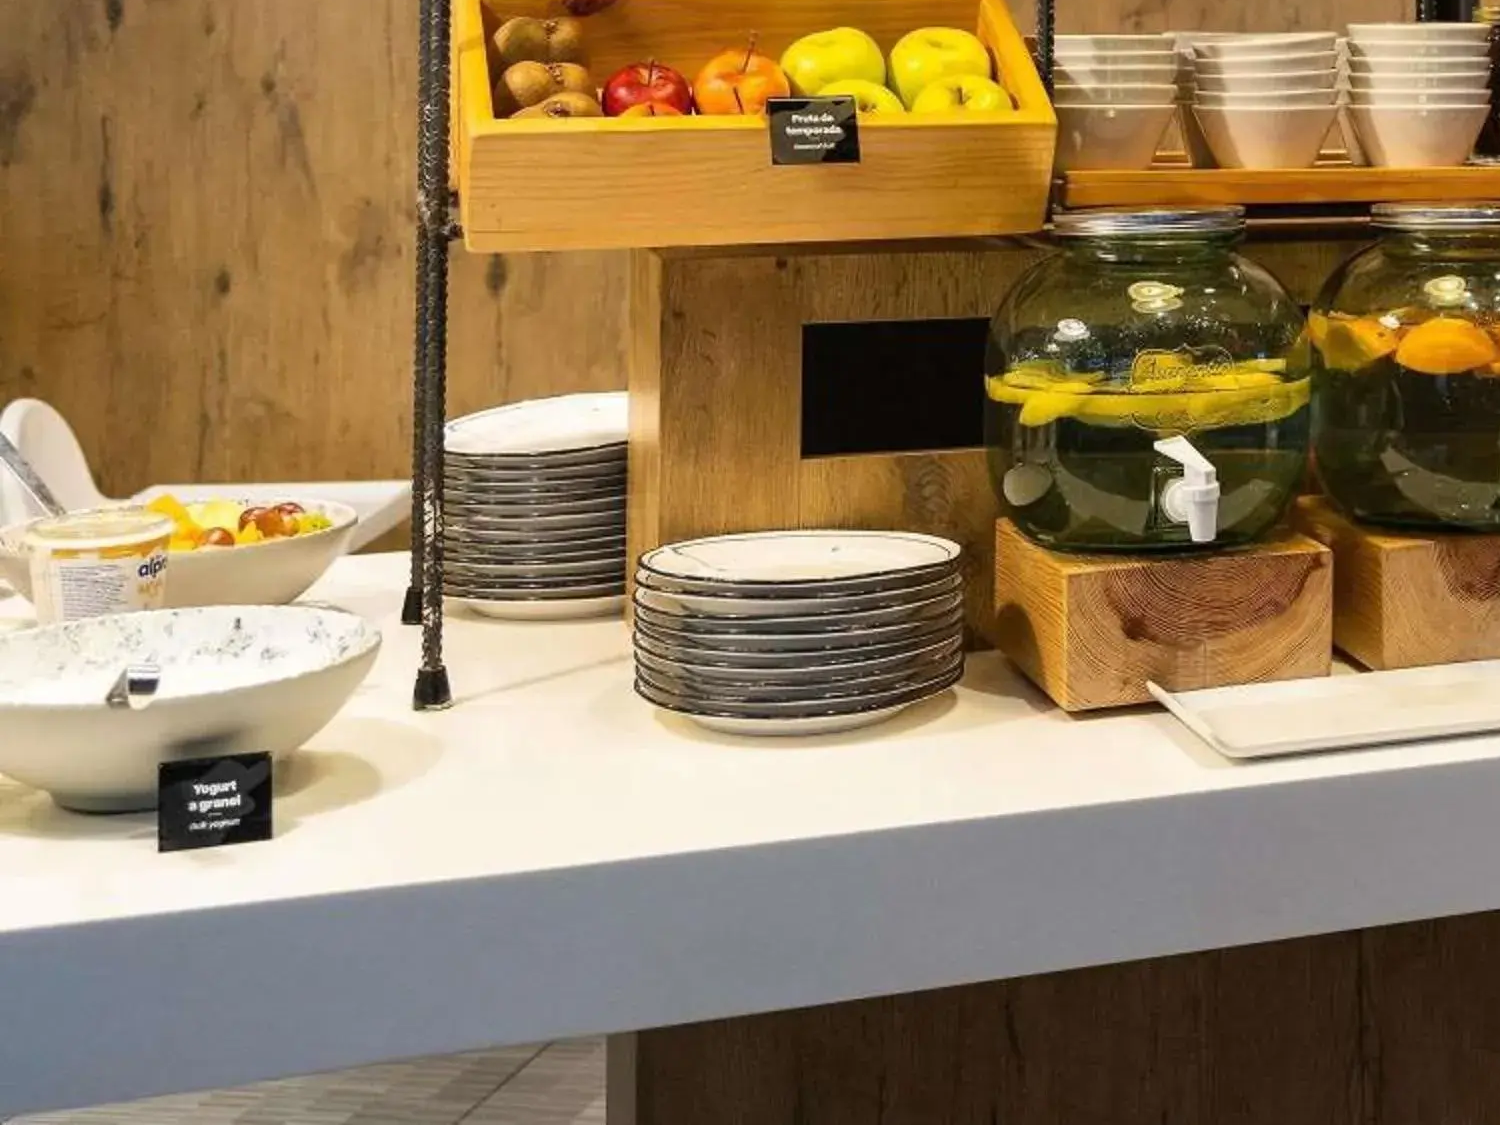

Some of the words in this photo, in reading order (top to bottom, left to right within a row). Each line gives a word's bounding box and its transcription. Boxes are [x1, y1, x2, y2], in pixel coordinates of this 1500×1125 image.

[193, 780, 237, 796] Yogurt
[188, 801, 197, 812] a
[199, 794, 241, 813] granel
